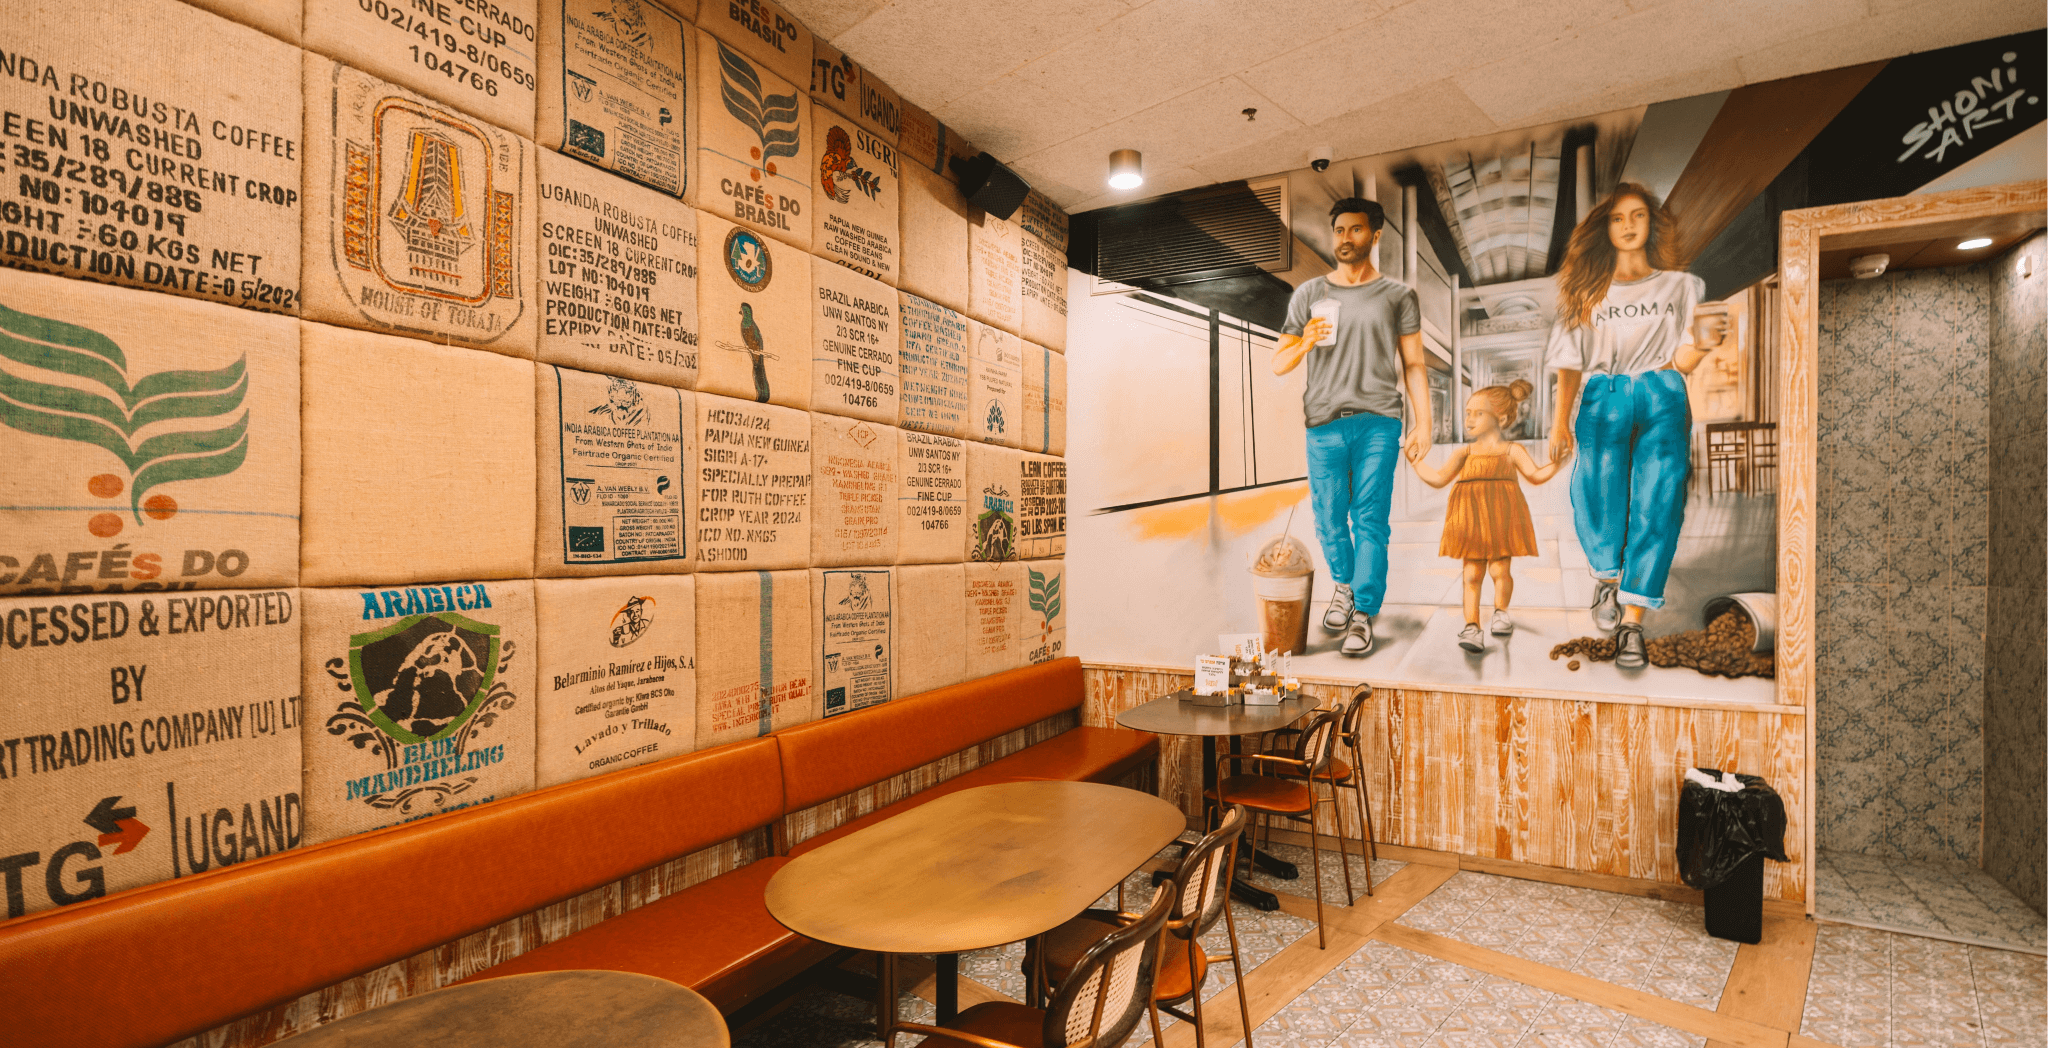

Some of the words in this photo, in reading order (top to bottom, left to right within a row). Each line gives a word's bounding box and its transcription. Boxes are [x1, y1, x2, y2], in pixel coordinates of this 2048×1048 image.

[452, 0, 534, 42] ERRADO
[459, 16, 507, 48] CUP
[729, 1, 786, 54] BRASIL
[775, 13, 797, 41] DO
[599, 42, 628, 62] Western
[409, 45, 498, 97] 104766
[49, 96, 201, 160] UNWASHED
[70, 73, 200, 136] ROBUSTA
[212, 120, 295, 161] COFFEE
[3, 111, 68, 151] EEN
[80, 134, 110, 162] 18
[126, 148, 239, 195] CURRENT
[245, 180, 297, 208] CROP
[856, 129, 898, 170] SIGRI
[541, 184, 600, 213] UGANDA
[603, 202, 658, 235] ROBUSTA
[734, 201, 791, 231] BRASIL
[779, 194, 801, 216] DO
[595, 217, 658, 251] UNWASHED
[823, 221, 839, 234] RAW
[839, 228, 866, 244] WASHED
[867, 238, 892, 255] ARABICA
[829, 213, 850, 230] PAPUA
[851, 224, 865, 235] NEW
[866, 229, 888, 244] GUINEA
[0, 230, 135, 279] DUCTION
[147, 234, 200, 264] KGS
[211, 248, 262, 275] NET
[543, 223, 602, 251] SCREEN
[607, 240, 619, 257] 18
[626, 247, 674, 273] CURRENT
[675, 261, 697, 279] CROP
[826, 242, 849, 257] CLEAN
[850, 251, 871, 266] SOUND
[872, 259, 877, 267] &
[877, 261, 891, 272] NEW
[834, 236, 861, 252] COFFEE
[862, 246, 883, 261] BEANS
[549, 259, 577, 278] LOT
[361, 287, 415, 317] HOUSE
[420, 300, 441, 321] OF
[448, 304, 501, 331] TORAJA
[546, 281, 600, 303] WEIGHT
[634, 303, 656, 319] KGS
[660, 308, 682, 325] NET
[819, 287, 851, 307] BRAZIL
[853, 297, 889, 318] ARABICA
[1595, 302, 1675, 327] AROMA
[546, 318, 601, 336] EXPIRY
[547, 300, 629, 332] PRODUCTION
[823, 305, 843, 321] UNW
[845, 311, 877, 329] SANTOS
[878, 319, 889, 333] NY
[836, 325, 847, 338] 2/3
[850, 328, 865, 342] SCR
[867, 333, 880, 345] 16+
[823, 339, 857, 358] GENUINE
[858, 347, 893, 365] CERRADO
[838, 359, 860, 374] FINE
[862, 364, 882, 378] CUP
[825, 373, 894, 396] 002/419-8/0659
[843, 393, 878, 408] 104766
[564, 422, 582, 433] INDIA
[584, 425, 611, 437] ARABICA
[612, 427, 635, 439] COFFEE
[637, 429, 671, 442] PLANTATION
[575, 436, 593, 446] From
[596, 438, 625, 448] Western
[627, 440, 645, 450] Ghats
[705, 428, 745, 446] PAPUA
[748, 434, 771, 450] NEW
[773, 437, 810, 453] GUINEA
[906, 432, 933, 445] BRAZIL
[933, 435, 962, 448] ARABICA
[572, 448, 610, 459] Fairtrade
[612, 451, 641, 462] Organic
[704, 448, 737, 465] SIGRI
[908, 447, 925, 458] UNW
[926, 449, 951, 461] SANTOS
[952, 452, 961, 461] NY
[703, 468, 769, 488] SPECIALLY
[918, 462, 927, 473] 2/3
[928, 463, 941, 474] SCR
[942, 464, 952, 474] 16+
[907, 476, 934, 488] GENUINE
[935, 478, 962, 489] CERRADO
[701, 488, 728, 503] FOR
[732, 489, 762, 505] RUTH
[765, 493, 807, 506] COFFEE
[918, 491, 935, 502] FINE
[936, 492, 952, 502] CUP
[983, 495, 1014, 513] ARABICA
[700, 508, 735, 522] CROP
[739, 510, 769, 524] YEAR
[773, 511, 802, 524] 2024
[907, 506, 962, 516] 002/419-8/0659
[921, 520, 949, 530] 104766
[181, 549, 250, 578] DO
[695, 548, 747, 562] ASHDOD
[360, 584, 492, 620] ARABICA
[0, 600, 129, 650] CESSED
[139, 599, 160, 637] &
[167, 591, 293, 635] EXPORTED
[1052, 640, 1061, 652] DO
[111, 665, 146, 705] BY
[553, 665, 606, 691] Belarminio
[609, 660, 645, 677] Ramírez
[647, 660, 652, 670] e
[654, 656, 677, 672] Hijos,
[590, 684, 605, 695] Altos
[606, 681, 616, 691] del
[575, 702, 601, 715] Certified
[602, 697, 624, 709] organic
[626, 696, 635, 705] by:
[651, 689, 662, 698] BCS
[631, 702, 648, 713] GmbH
[24, 721, 135, 774] TRADING
[140, 705, 244, 755] COMPANY
[249, 700, 276, 738] [U]
[281, 695, 301, 729] LT
[574, 724, 618, 755] Lavado
[621, 723, 628, 734] y
[631, 718, 672, 736] Trillado
[404, 736, 457, 765] BLUE
[589, 753, 622, 769] ORGANIC
[623, 743, 658, 760] COFFEE
[346, 744, 504, 800] MANDHELING
